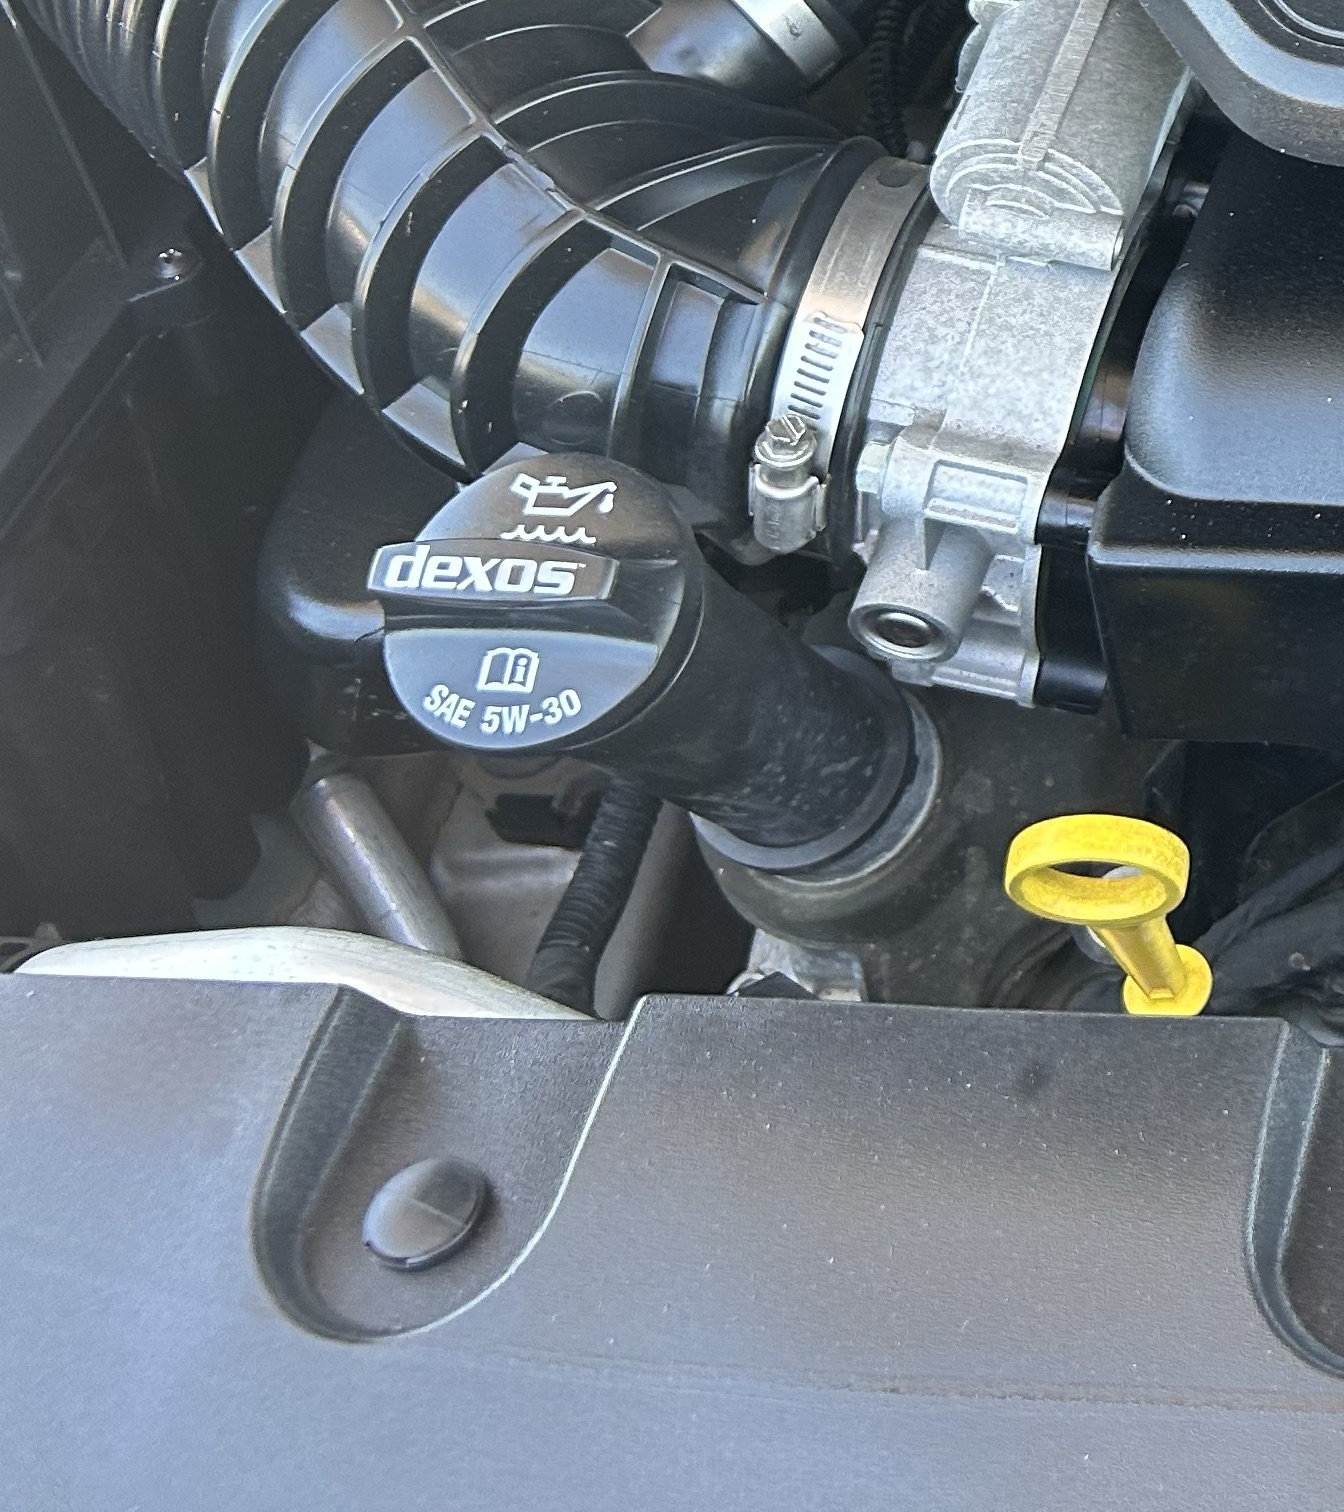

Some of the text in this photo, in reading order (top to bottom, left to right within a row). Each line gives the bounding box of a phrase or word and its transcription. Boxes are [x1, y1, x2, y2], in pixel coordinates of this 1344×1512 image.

[385, 544, 577, 596] dexos
[423, 683, 583, 735] SAE 5W-30
